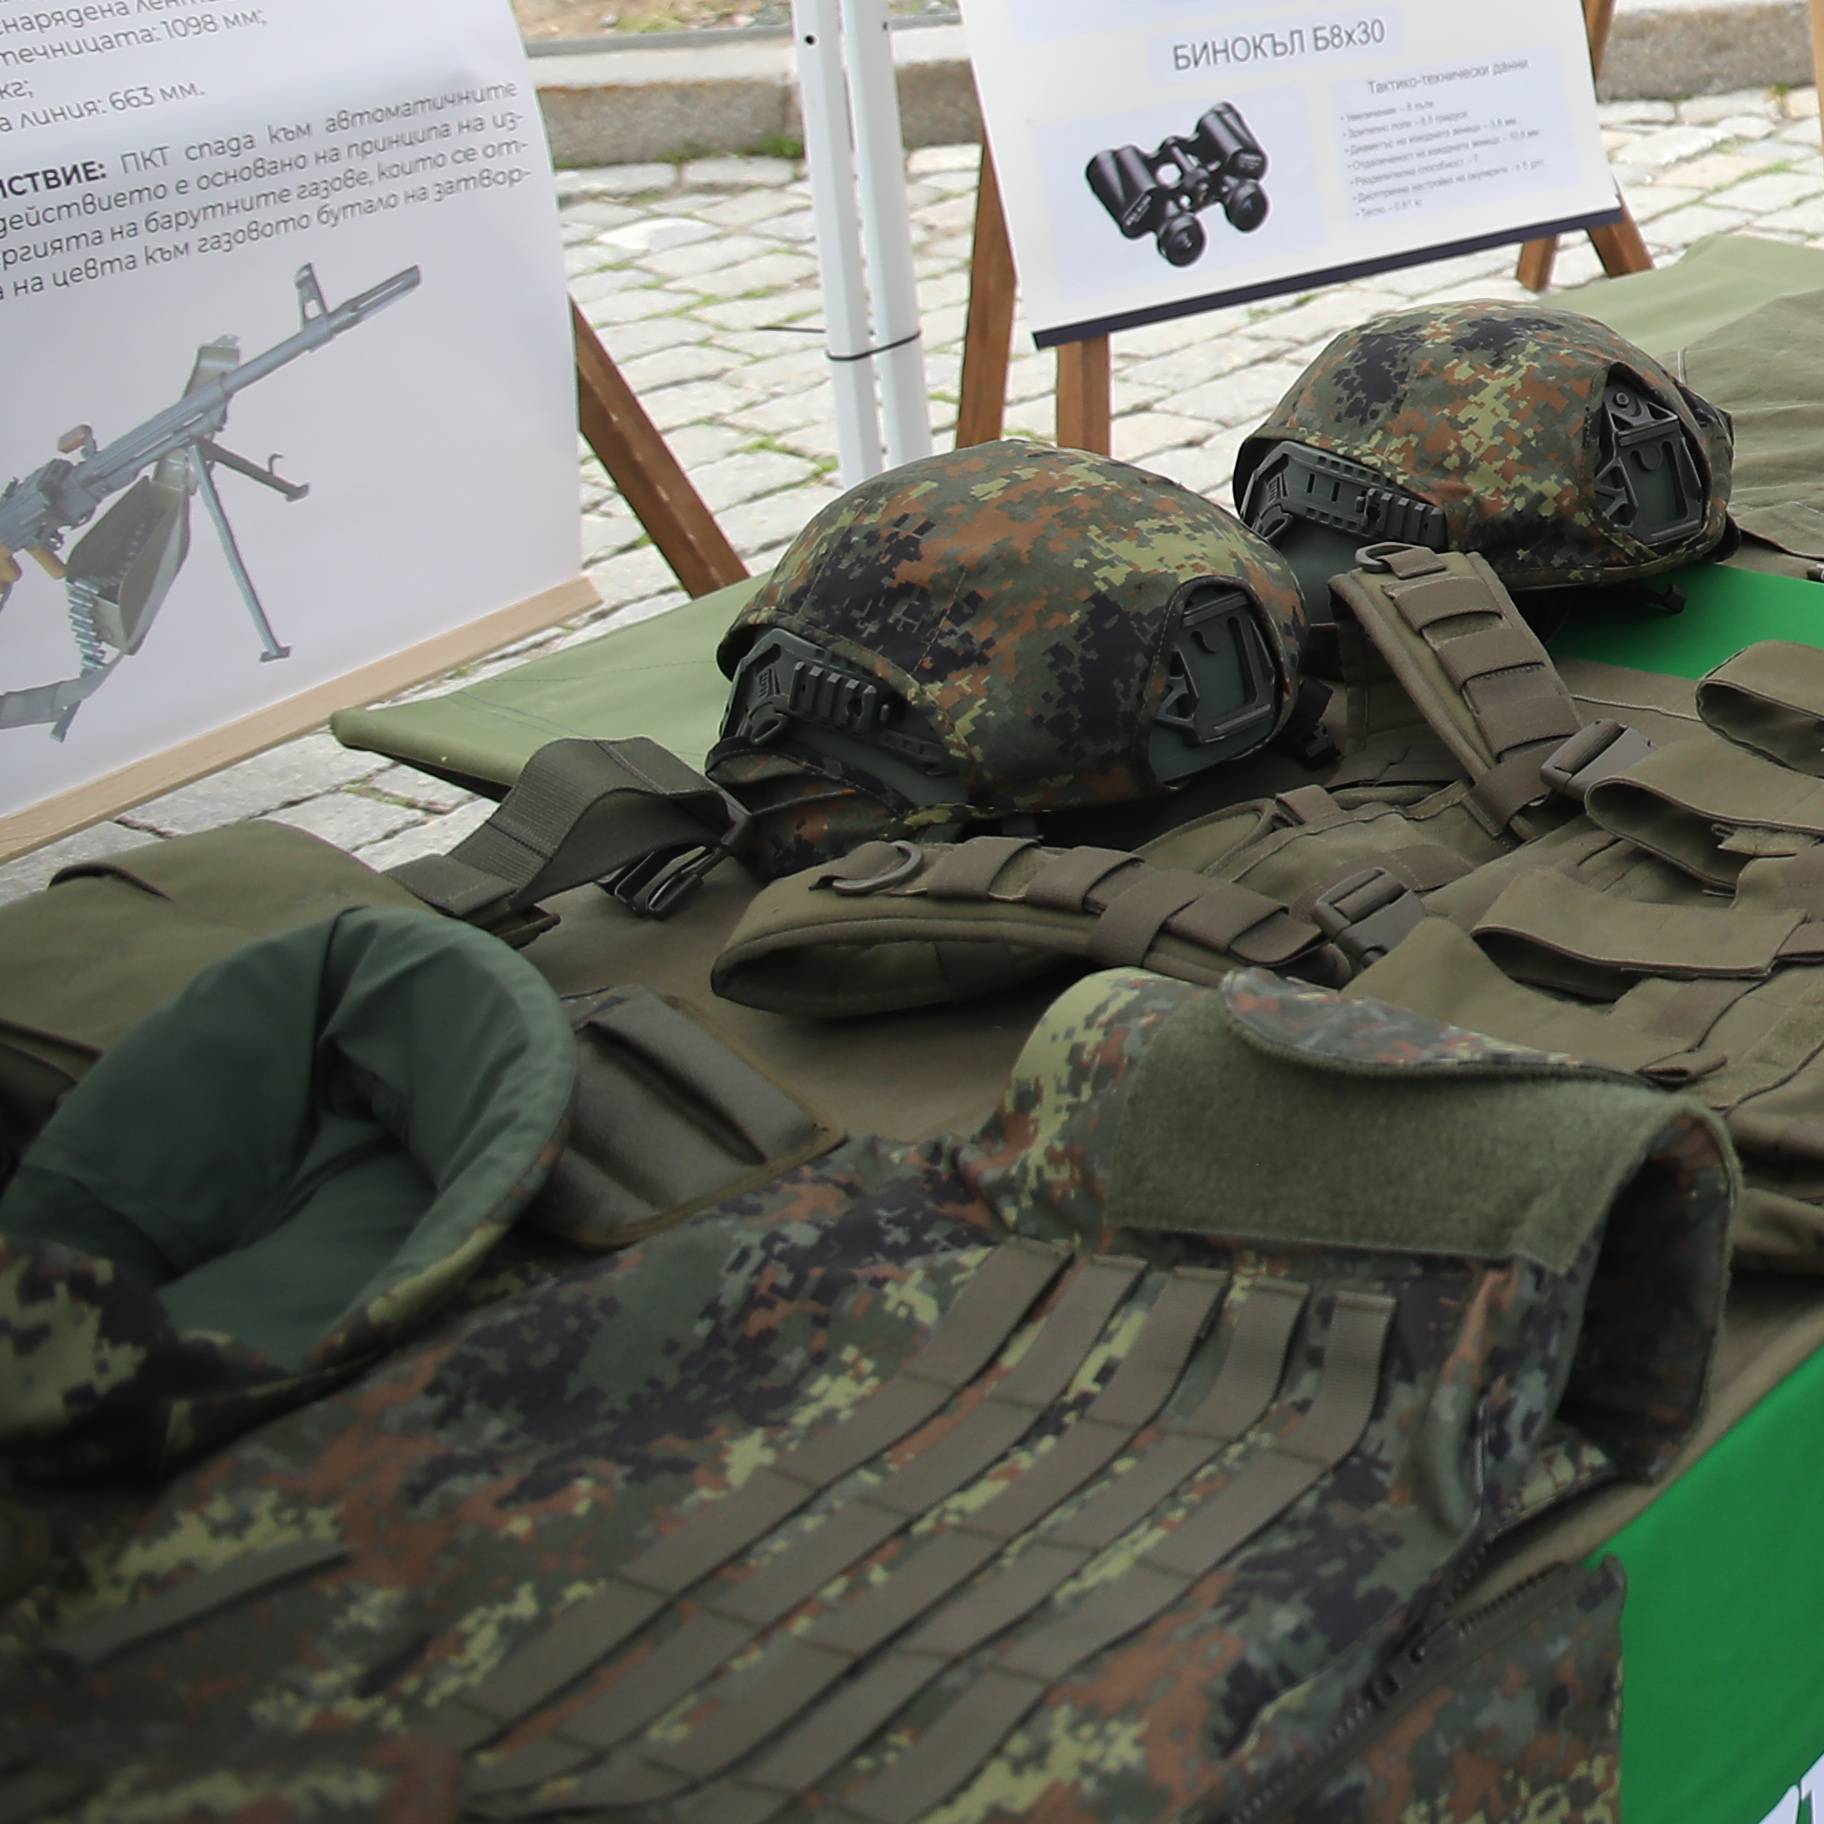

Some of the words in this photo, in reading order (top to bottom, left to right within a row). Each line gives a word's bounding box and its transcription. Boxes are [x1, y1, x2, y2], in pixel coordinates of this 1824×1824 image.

[0, 0, 130, 36] нарядена
[160, 13, 219, 42] 1098
[223, 8, 267, 31] мм;
[1173, 29, 1305, 71] БИНОКЪЛ
[1313, 18, 1386, 52] Б8х30
[20, 96, 108, 130] линия:
[108, 85, 155, 112] 663
[159, 81, 206, 103] мм.
[120, 144, 171, 175] ПКТ
[185, 132, 257, 162] спада
[267, 121, 312, 145] към
[325, 81, 518, 133] автоматичните
[175, 178, 189, 195] е
[196, 152, 308, 192] основано
[314, 146, 341, 168] на
[346, 121, 451, 160] принципа
[457, 115, 486, 135] на
[491, 110, 525, 132] из-
[0, 228, 104, 270] ргията
[109, 220, 138, 243] на
[145, 186, 292, 234] барутните
[296, 167, 375, 200] газове,
[376, 152, 448, 182] които
[450, 145, 479, 165] се
[481, 138, 529, 161] от-
[13, 275, 45, 298] на
[52, 253, 138, 288] цевта
[144, 240, 190, 267] към
[197, 212, 310, 254] газовото
[316, 192, 399, 228] бутало
[403, 185, 430, 206] на
[433, 166, 533, 202] затвор-
